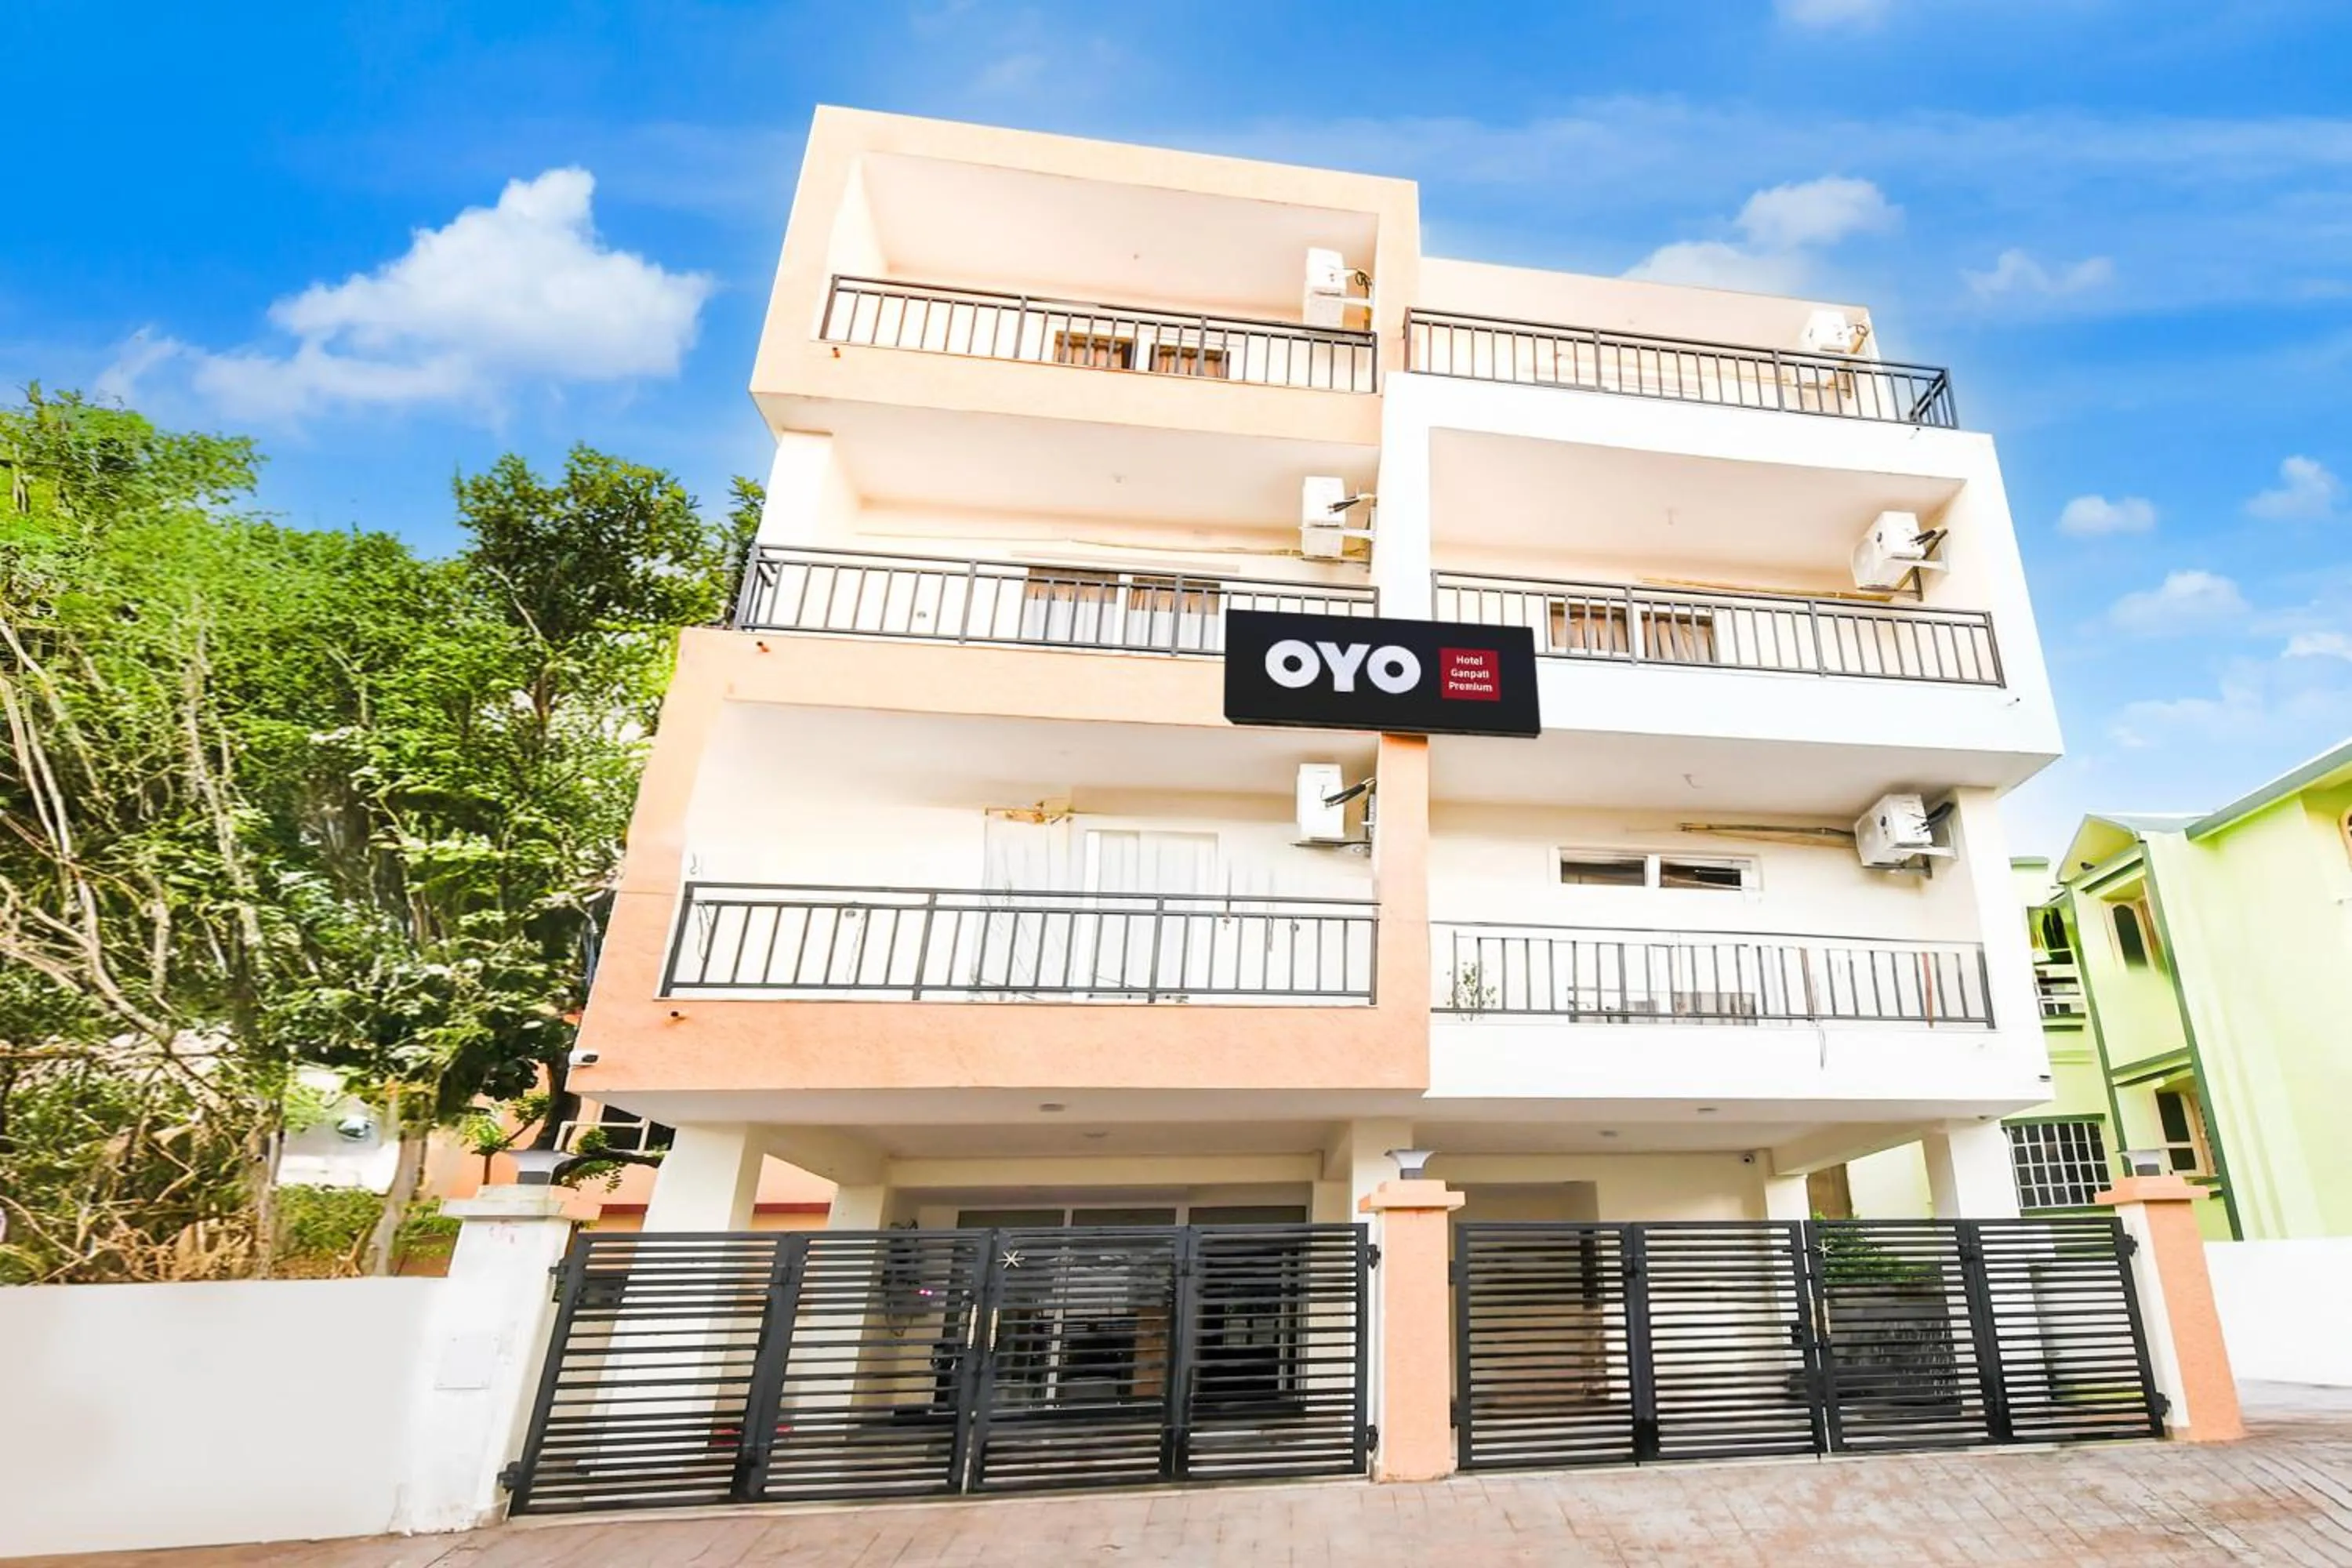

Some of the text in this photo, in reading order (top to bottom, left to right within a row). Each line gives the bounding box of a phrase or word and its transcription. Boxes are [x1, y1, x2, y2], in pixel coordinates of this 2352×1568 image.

[1456, 655, 1483, 666] Hotel
[1265, 639, 1421, 694] OYO
[1450, 668, 1490, 680] Ganpati
[1448, 681, 1494, 692] Premium
